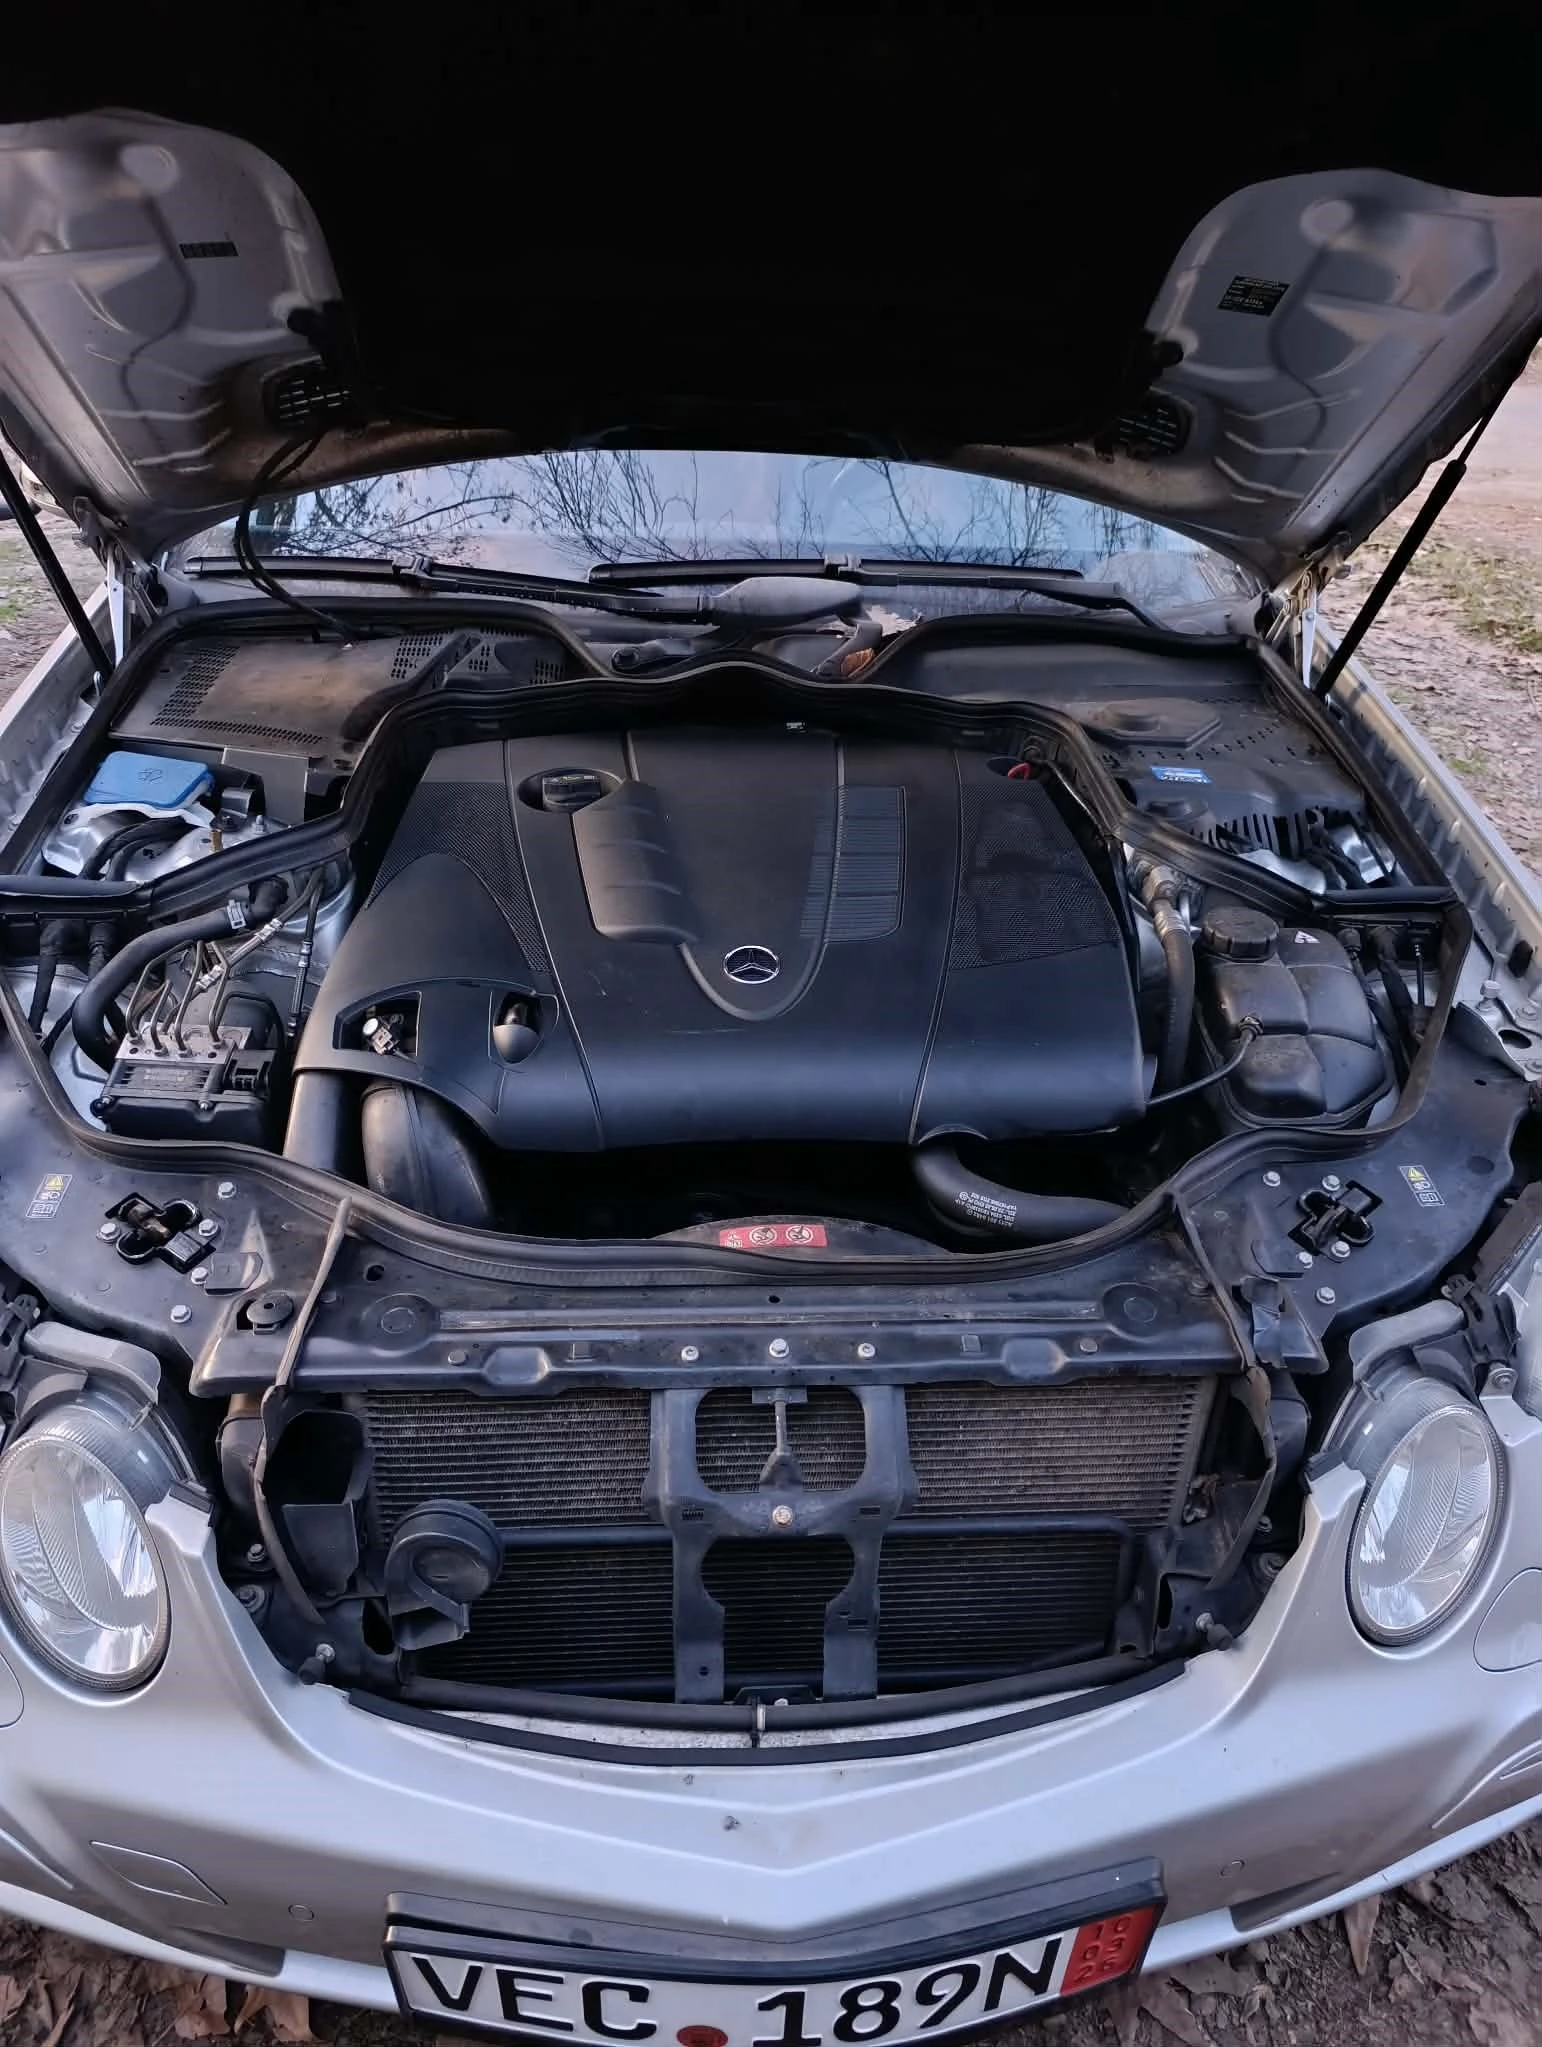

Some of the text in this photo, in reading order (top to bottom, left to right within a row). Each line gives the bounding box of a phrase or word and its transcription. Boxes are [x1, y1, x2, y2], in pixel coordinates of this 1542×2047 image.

[1095, 1915, 1132, 1940] 10
[1083, 1937, 1125, 1961] 03
[411, 1937, 1063, 2047] VEC 189N
